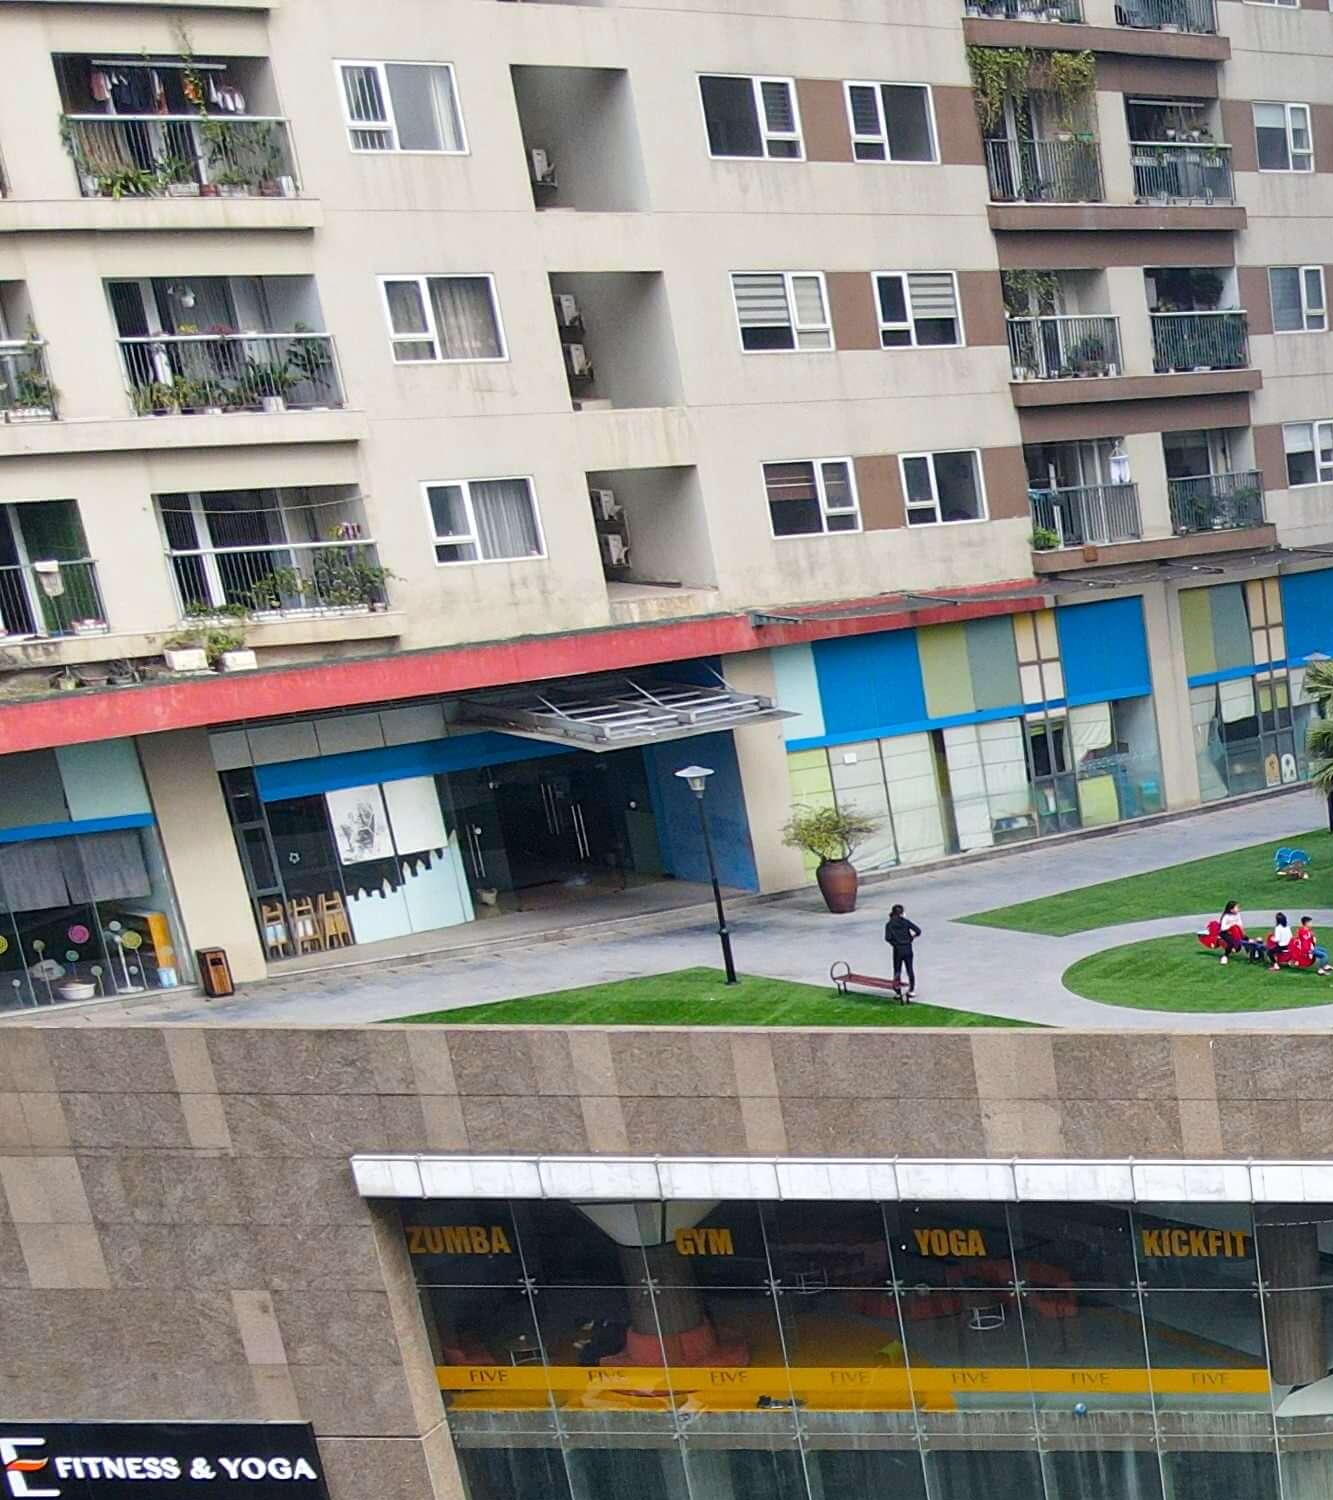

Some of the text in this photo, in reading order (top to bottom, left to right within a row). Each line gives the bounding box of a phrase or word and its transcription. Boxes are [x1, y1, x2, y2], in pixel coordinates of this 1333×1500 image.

[406, 1225, 512, 1255] ZUMBA
[674, 1227, 734, 1256] GYM
[912, 1228, 987, 1257] YOGA
[1142, 1229, 1248, 1258] KICKFIT
[55, 1457, 318, 1480] FITNESS & YOGA
